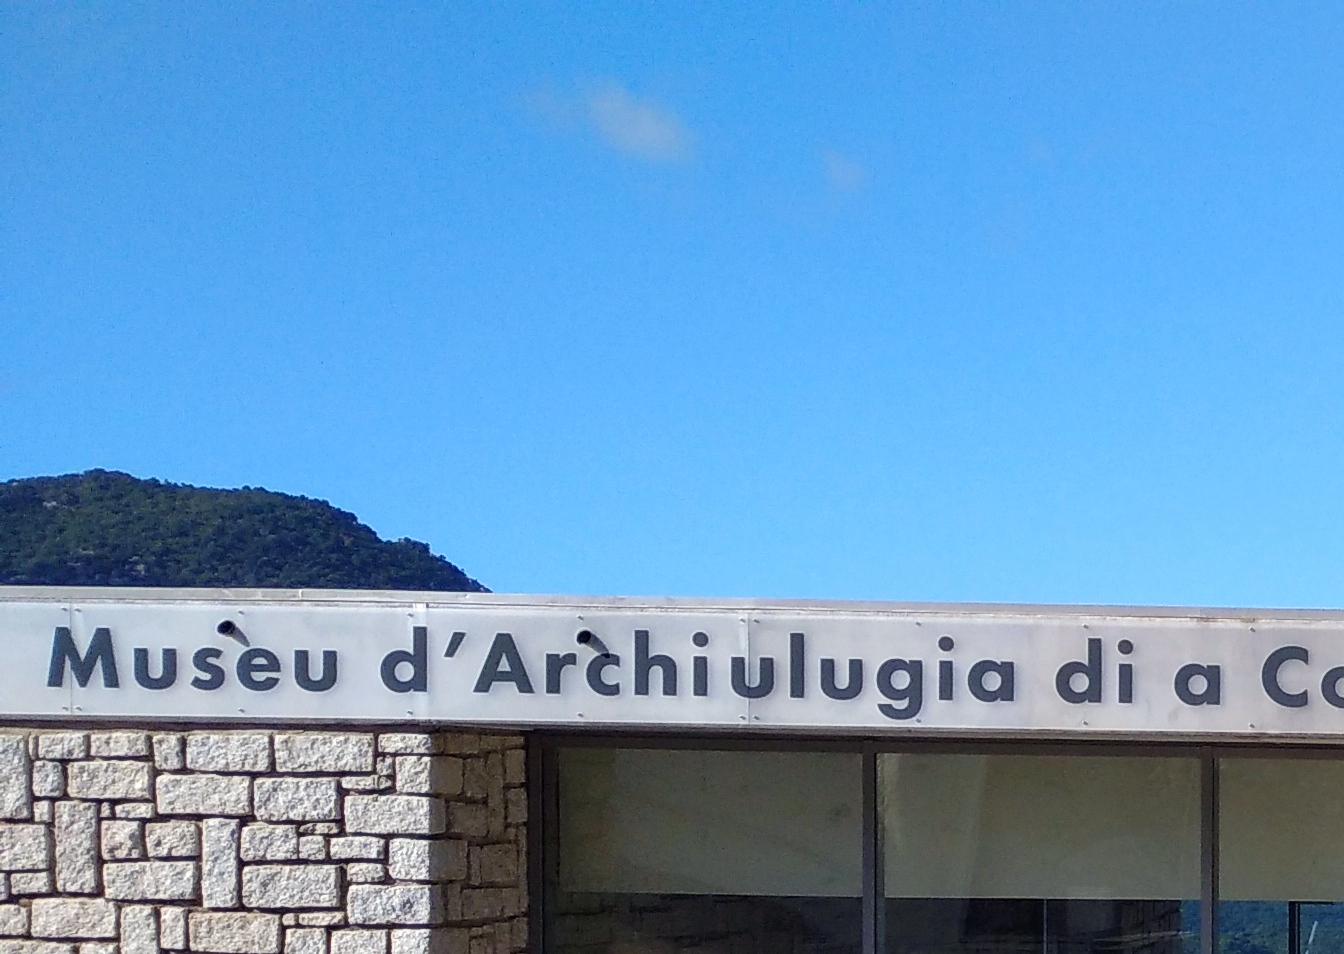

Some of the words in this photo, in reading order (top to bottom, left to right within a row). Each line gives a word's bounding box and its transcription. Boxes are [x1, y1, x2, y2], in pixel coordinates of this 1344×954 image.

[380, 626, 1015, 720] d'Archiulugia
[1055, 637, 1134, 704] di
[1174, 663, 1221, 707] a
